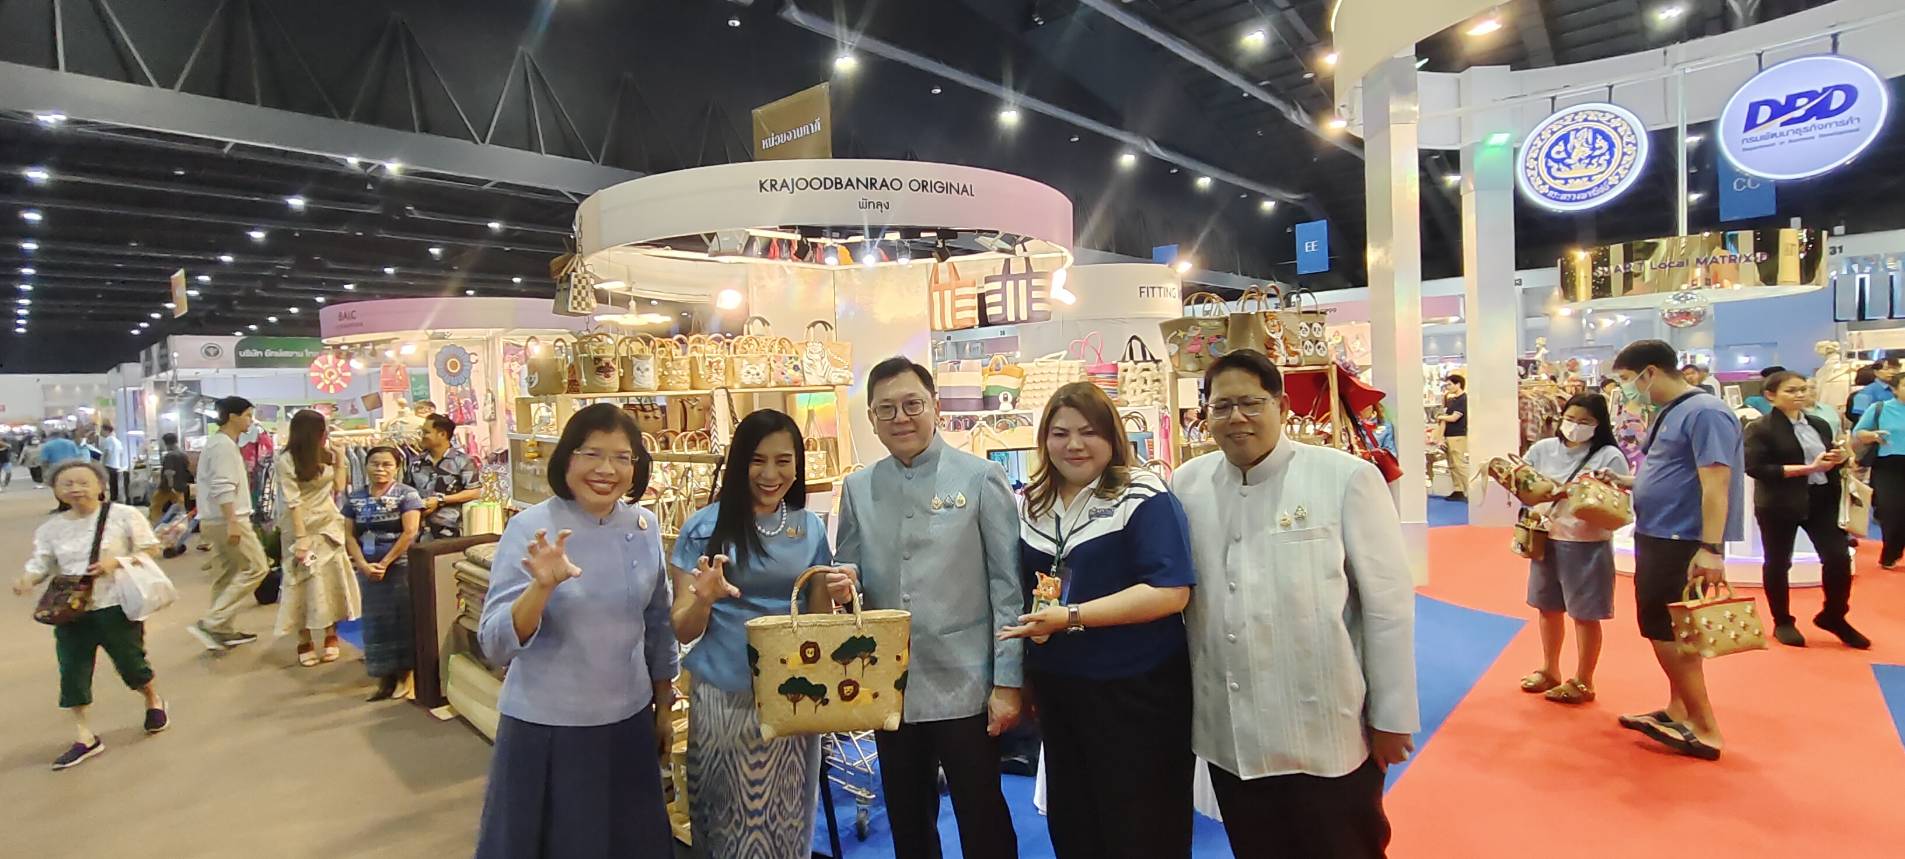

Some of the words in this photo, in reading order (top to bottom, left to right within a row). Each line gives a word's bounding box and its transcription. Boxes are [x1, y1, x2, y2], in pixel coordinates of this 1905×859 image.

[1743, 84, 1858, 133] DBD
[759, 177, 903, 194] KRAJOODBANRAO
[908, 179, 975, 196] ORIGINAL
[858, 198, 890, 212] พัทลุง
[1305, 240, 1318, 252] EE
[1650, 259, 1689, 270] Local
